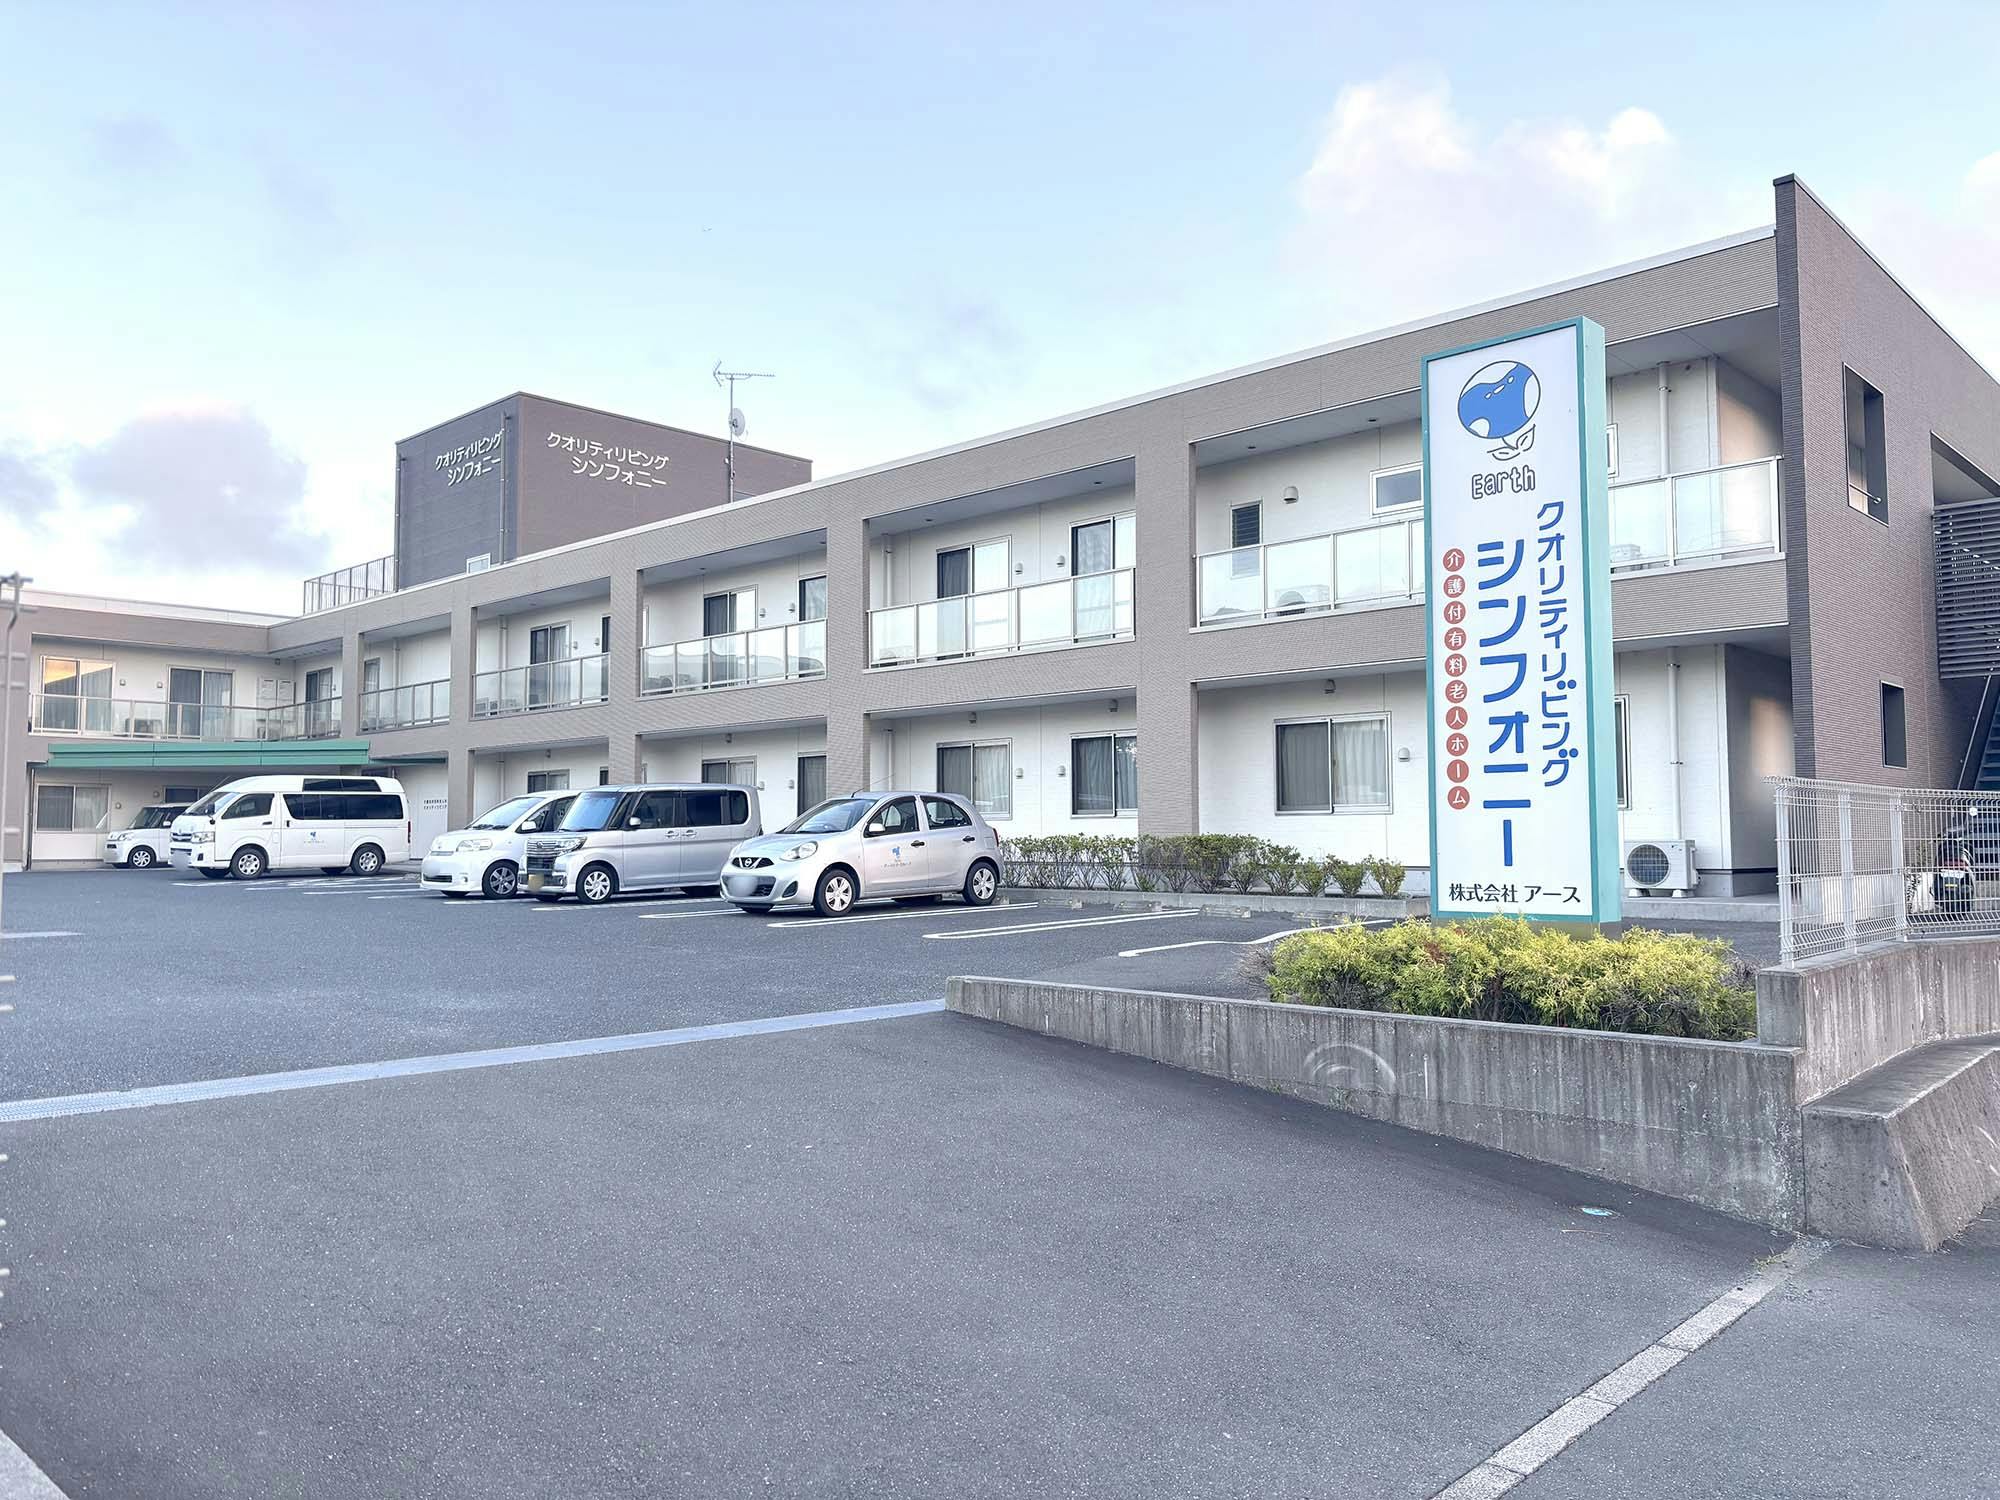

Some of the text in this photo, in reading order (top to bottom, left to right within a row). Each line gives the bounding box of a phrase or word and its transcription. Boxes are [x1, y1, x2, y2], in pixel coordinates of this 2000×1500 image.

[435, 428, 504, 471] クオリティリビング
[547, 432, 669, 470] クオリティリビング
[448, 455, 501, 486] シンフォニー
[572, 456, 667, 487] シンフォニー
[1471, 465, 1536, 500] Earth
[1537, 501, 1579, 787] クオリティリビング
[1445, 550, 1468, 807] 介護付有料老人ホーム
[1477, 539, 1531, 866] シンフォニー
[1448, 883, 1581, 903] 株式会社 アース
